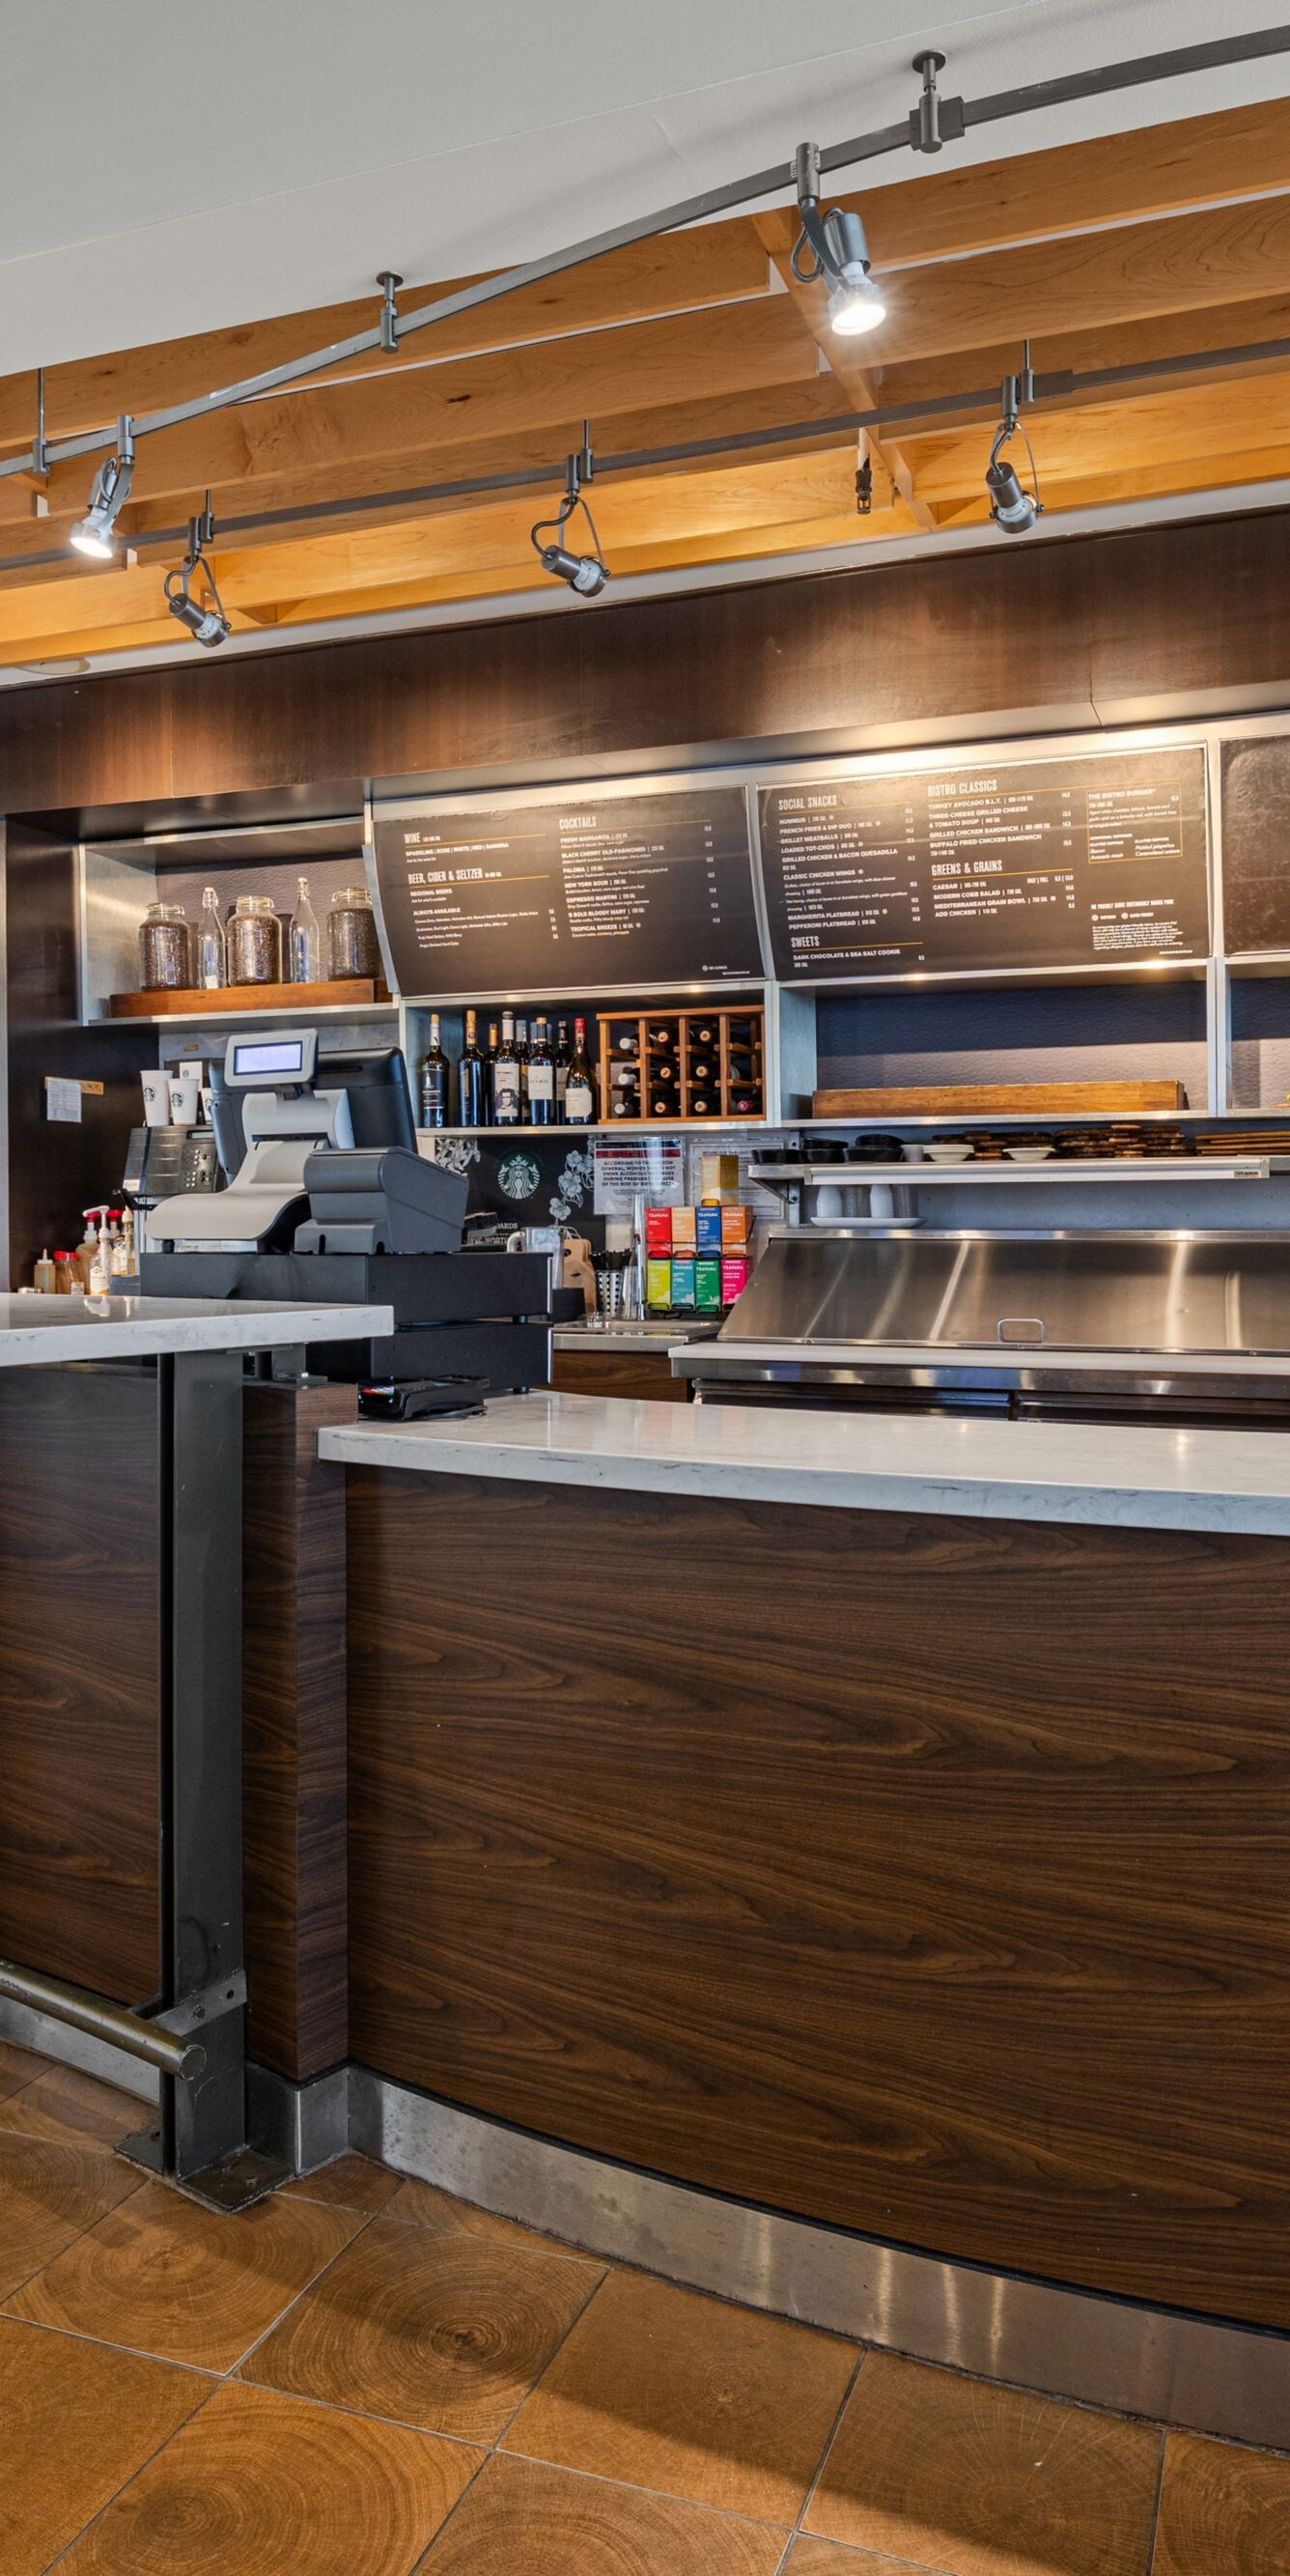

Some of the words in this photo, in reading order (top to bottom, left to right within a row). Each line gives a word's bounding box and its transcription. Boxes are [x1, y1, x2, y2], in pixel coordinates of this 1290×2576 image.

[927, 783, 956, 797] BISTRO
[959, 778, 997, 795] CLASSICS
[778, 797, 805, 811] SOCIAL
[807, 794, 838, 808] SNACKS
[953, 799, 985, 807] AVOCADO
[985, 797, 1002, 806] B.L.T.
[929, 809, 975, 820] THREE-CHEESE
[559, 816, 597, 830] COCKTAILS
[984, 825, 1019, 834] SANDWICH
[404, 832, 421, 844] WINE
[804, 834, 838, 842] MEATBALLS
[1007, 834, 1042, 842] SANDWICH
[602, 845, 646, 856] OLD-FASHIONED
[562, 865, 586, 874] PALOMA
[931, 863, 962, 876] GREENS
[964, 863, 971, 873] &
[973, 860, 1003, 873] GRAINS
[407, 873, 427, 885] BEER,
[427, 871, 447, 883] CIDER
[448, 870, 455, 881] &
[456, 868, 483, 881] SELTZER
[934, 900, 987, 910] MEDITERRANEAN
[571, 924, 596, 933] TROPICAL
[791, 935, 820, 948] SWEETS
[809, 951, 844, 960] CHOCOLATE
